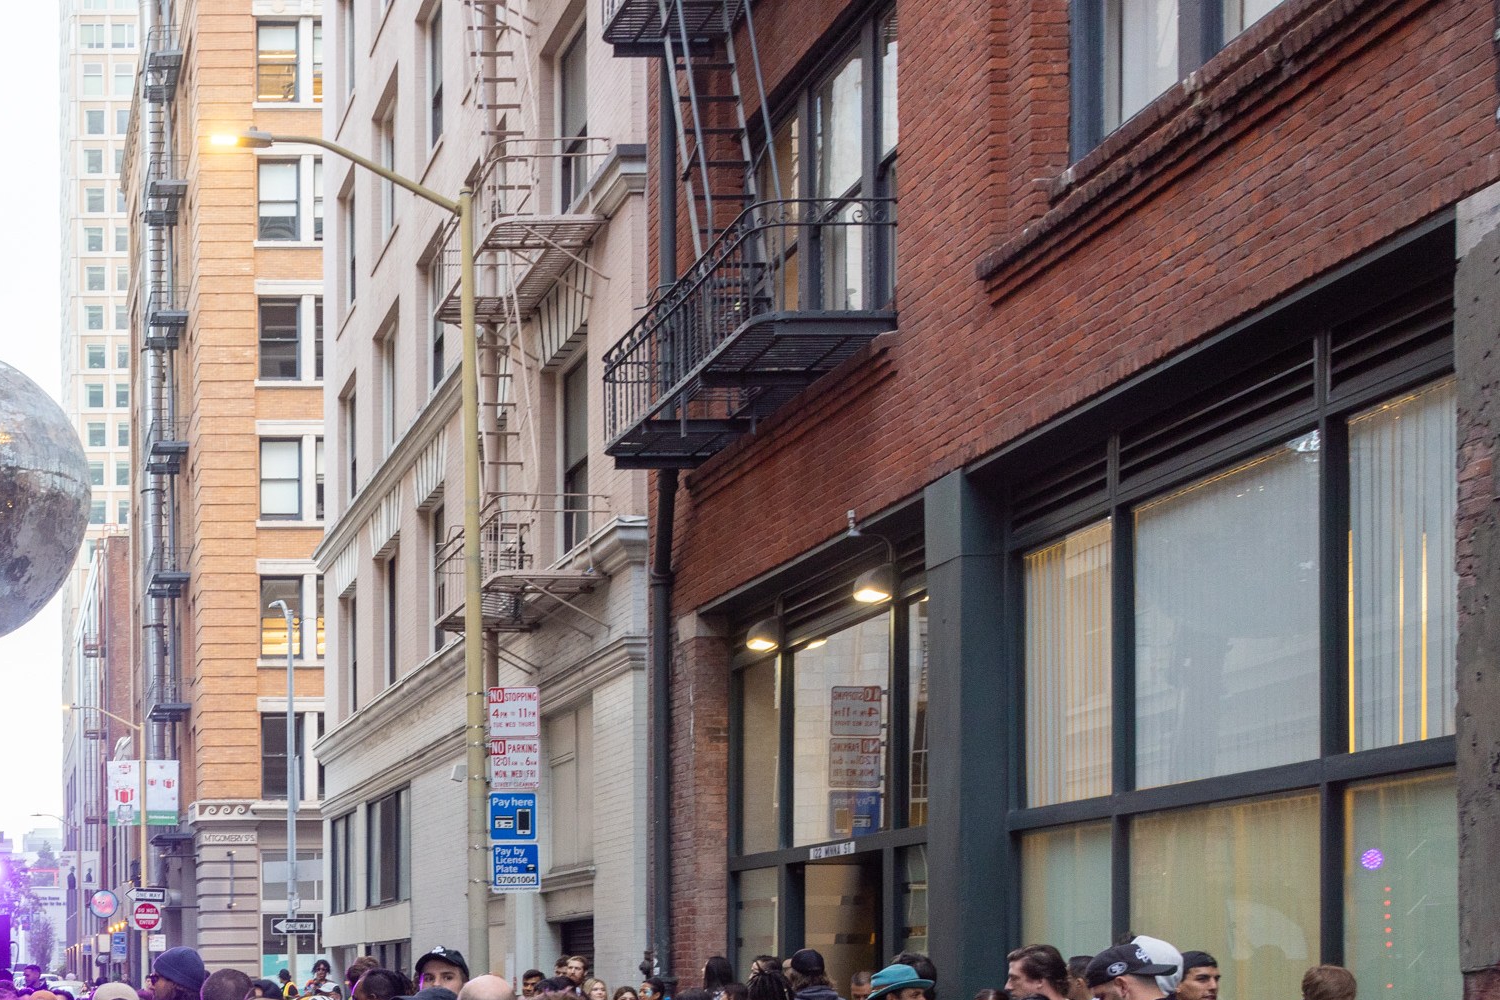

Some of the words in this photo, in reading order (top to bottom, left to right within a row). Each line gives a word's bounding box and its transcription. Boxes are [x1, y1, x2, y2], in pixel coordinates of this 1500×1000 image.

[490, 689, 503, 702] NO
[505, 692, 536, 701] STOPPING
[492, 709, 507, 718] 4PM
[518, 708, 536, 718] 11PM
[491, 741, 504, 754] NO
[508, 744, 537, 753] PARKING
[495, 770, 506, 778] MON
[492, 798, 510, 808] Pay
[511, 797, 533, 806] here
[495, 847, 511, 857] Pay
[513, 847, 525, 857] by
[844, 842, 851, 854] ST
[495, 856, 528, 864] License
[495, 865, 518, 873] Plate
[498, 876, 536, 884] 57001004
